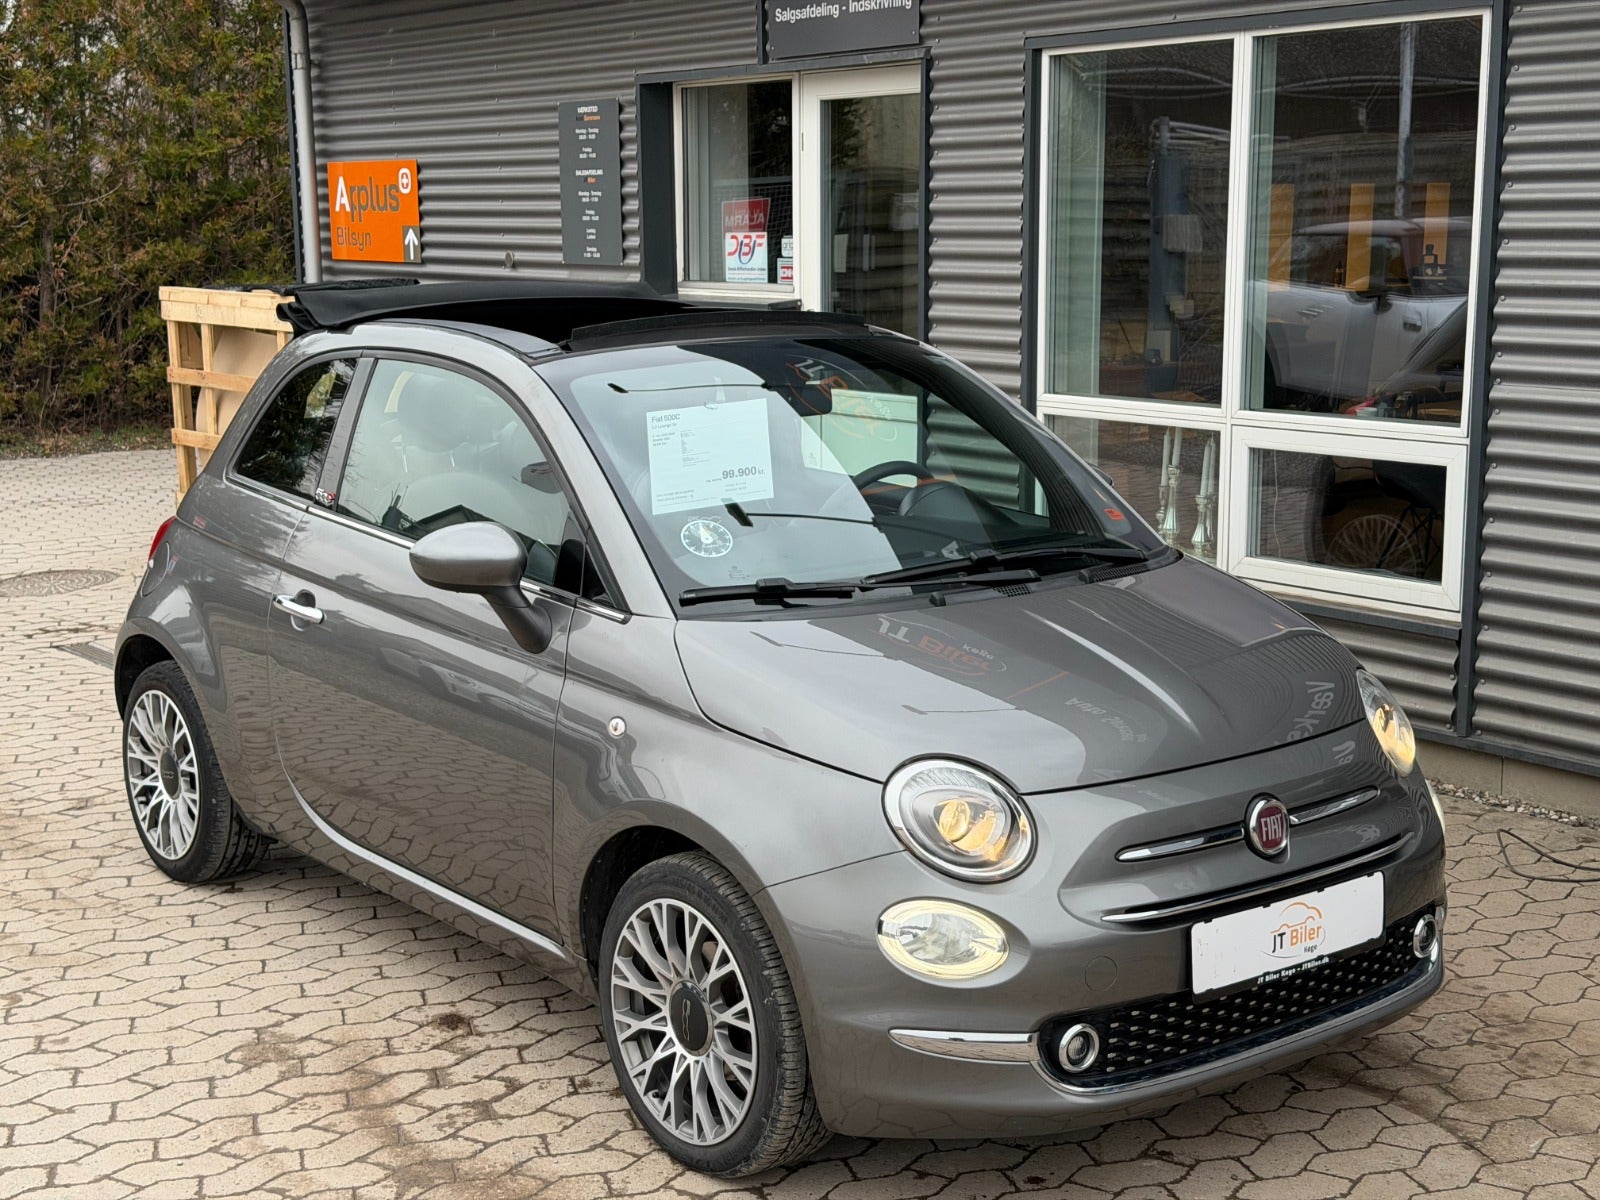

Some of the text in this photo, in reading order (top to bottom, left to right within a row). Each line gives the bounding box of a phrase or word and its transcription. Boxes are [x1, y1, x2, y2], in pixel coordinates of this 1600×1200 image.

[775, 4, 840, 24] Salgsafdeling
[336, 226, 372, 252] Bilsyn
[651, 415, 663, 423] Fiat
[722, 466, 757, 480] 99.900
[1261, 813, 1282, 841] FIAT
[1272, 925, 1322, 953] JT Biler
[1257, 977, 1264, 985] JT
[1265, 973, 1280, 982] Biler
